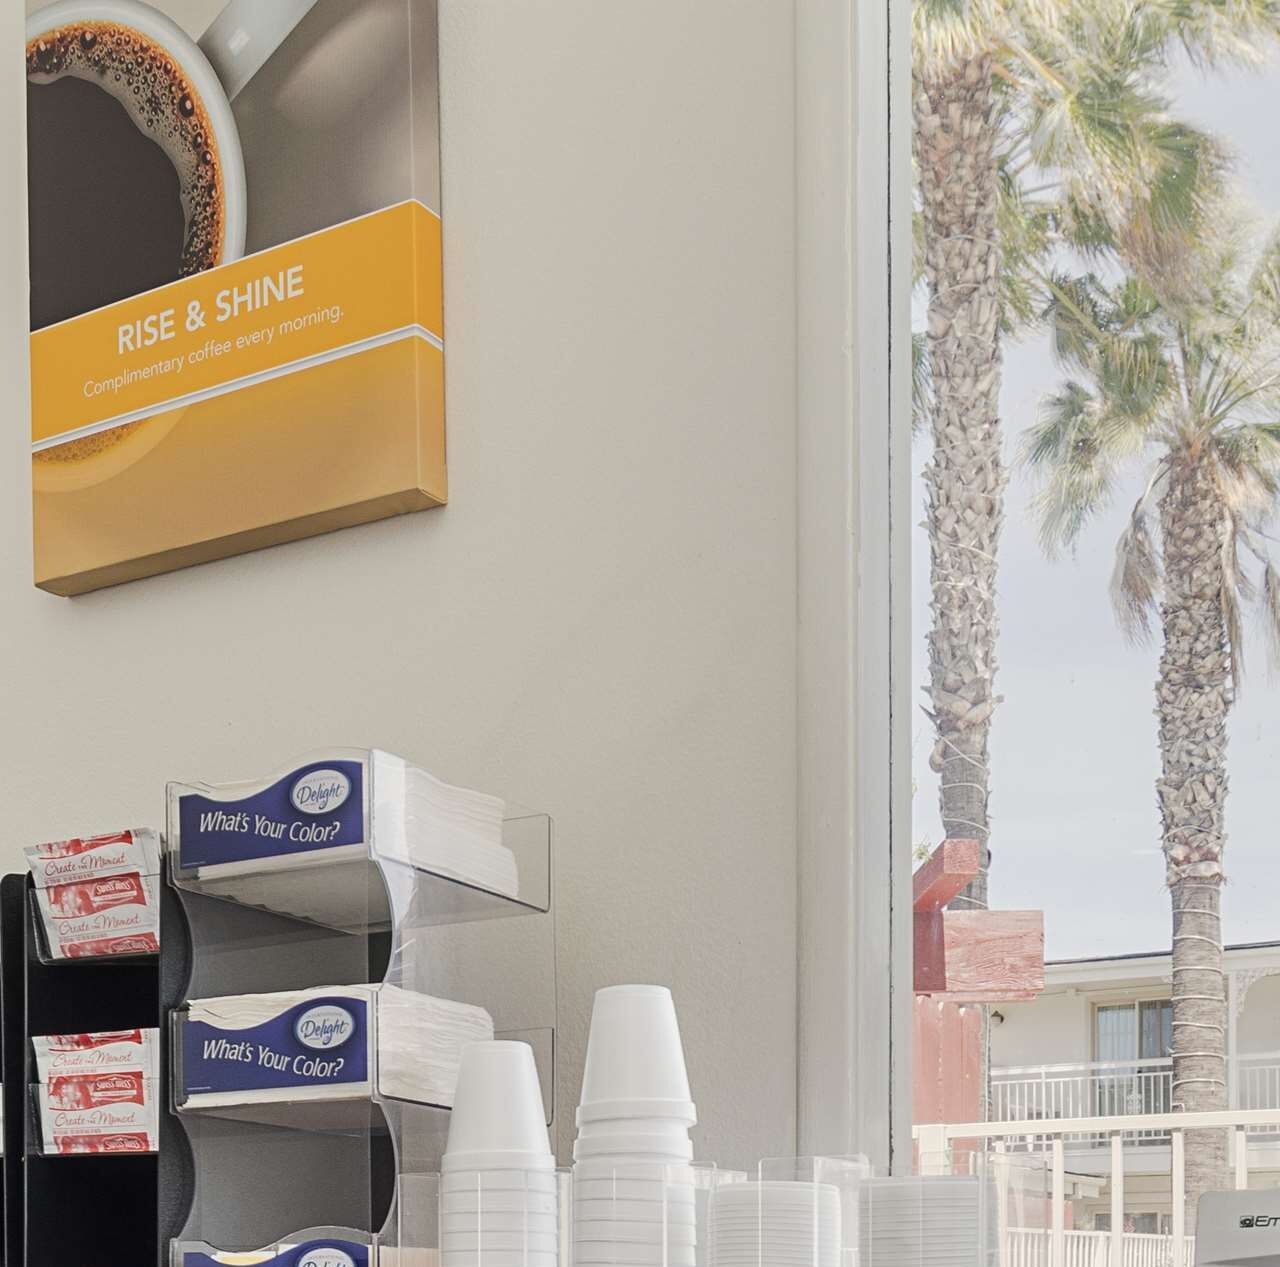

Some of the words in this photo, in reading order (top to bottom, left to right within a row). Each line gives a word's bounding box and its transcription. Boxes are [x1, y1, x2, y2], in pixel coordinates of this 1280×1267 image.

[117, 308, 175, 354] RISE
[185, 300, 206, 333] &
[215, 264, 304, 322] SHINE
[83, 355, 185, 398] Complimentary
[188, 339, 232, 365] coffee
[235, 326, 275, 350] every
[279, 305, 345, 337] morning.
[297, 783, 345, 810] Delight
[200, 811, 249, 832] What's
[254, 814, 287, 839] Your
[290, 821, 340, 842] Color?
[45, 861, 75, 876] Create
[301, 1018, 349, 1045] Delight
[203, 1040, 253, 1063] What's
[257, 1046, 291, 1072] Your
[293, 1055, 344, 1078] Color?
